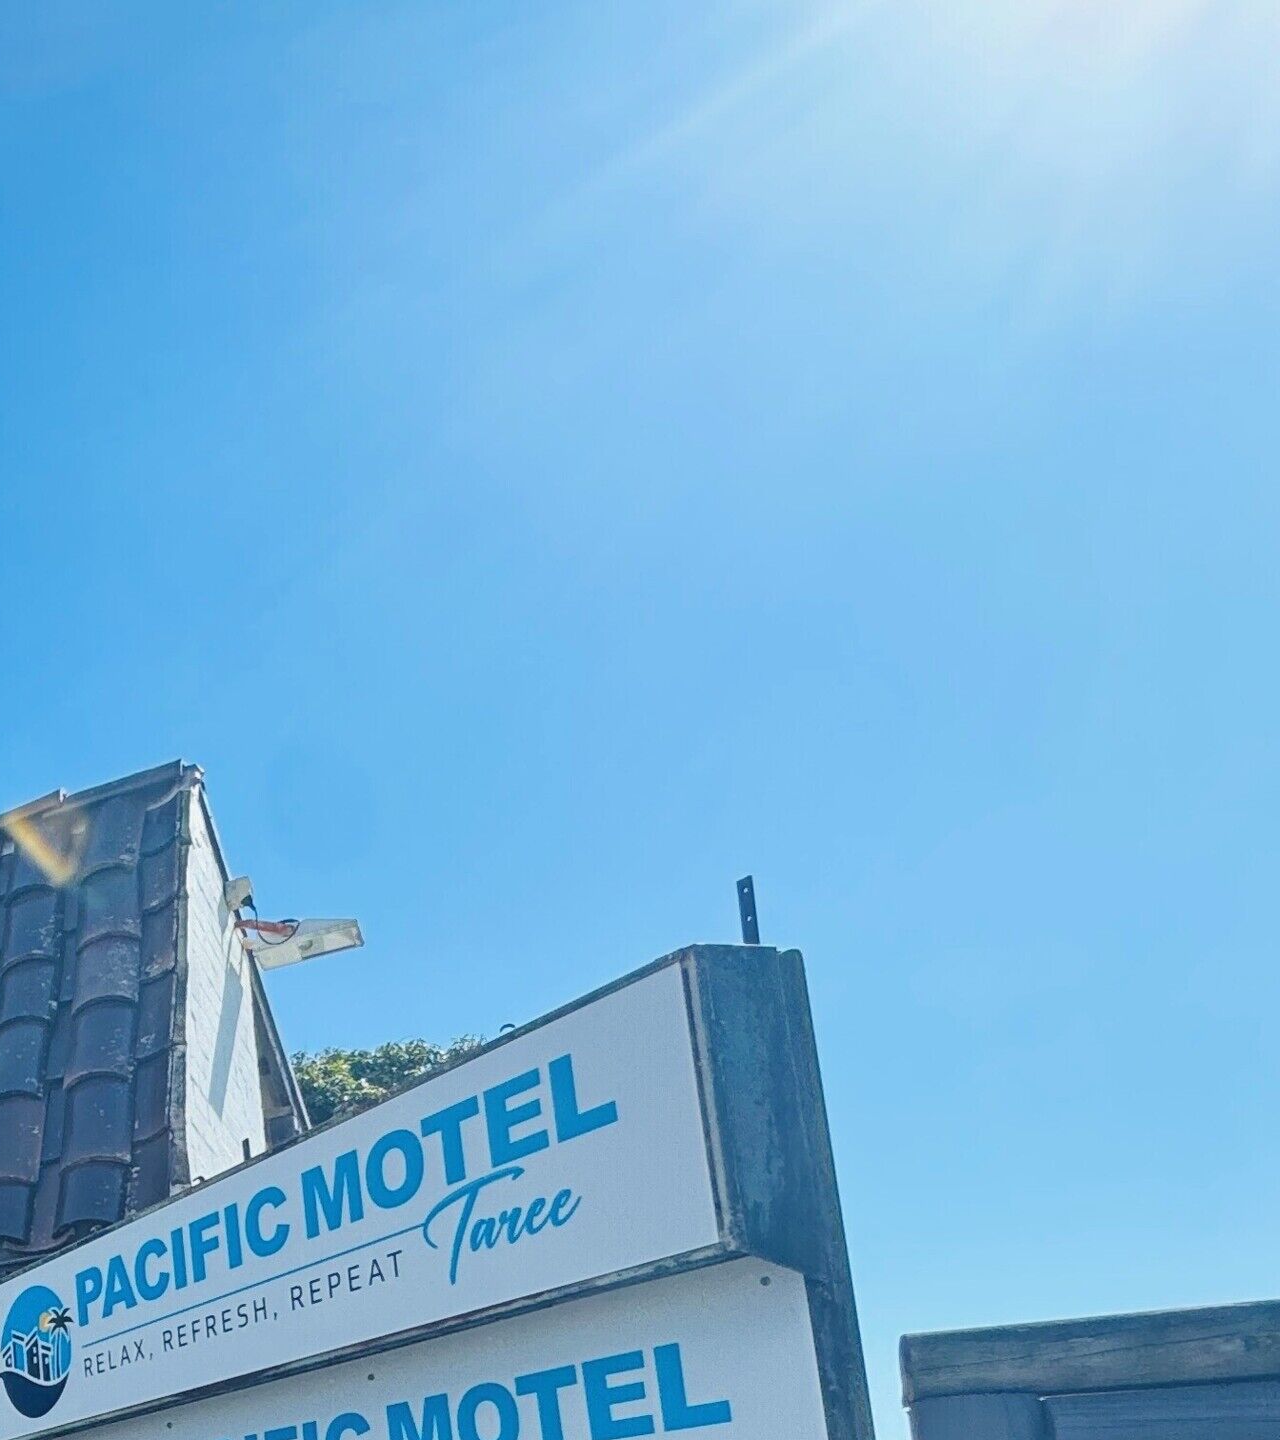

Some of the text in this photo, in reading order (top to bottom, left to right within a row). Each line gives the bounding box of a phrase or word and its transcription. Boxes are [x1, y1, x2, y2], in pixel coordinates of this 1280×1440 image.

[75, 1052, 618, 1328] PACIFIC MOTEL
[423, 1166, 582, 1285] Taree
[82, 1251, 404, 1379] RELAX, REFRESH, REPEAT
